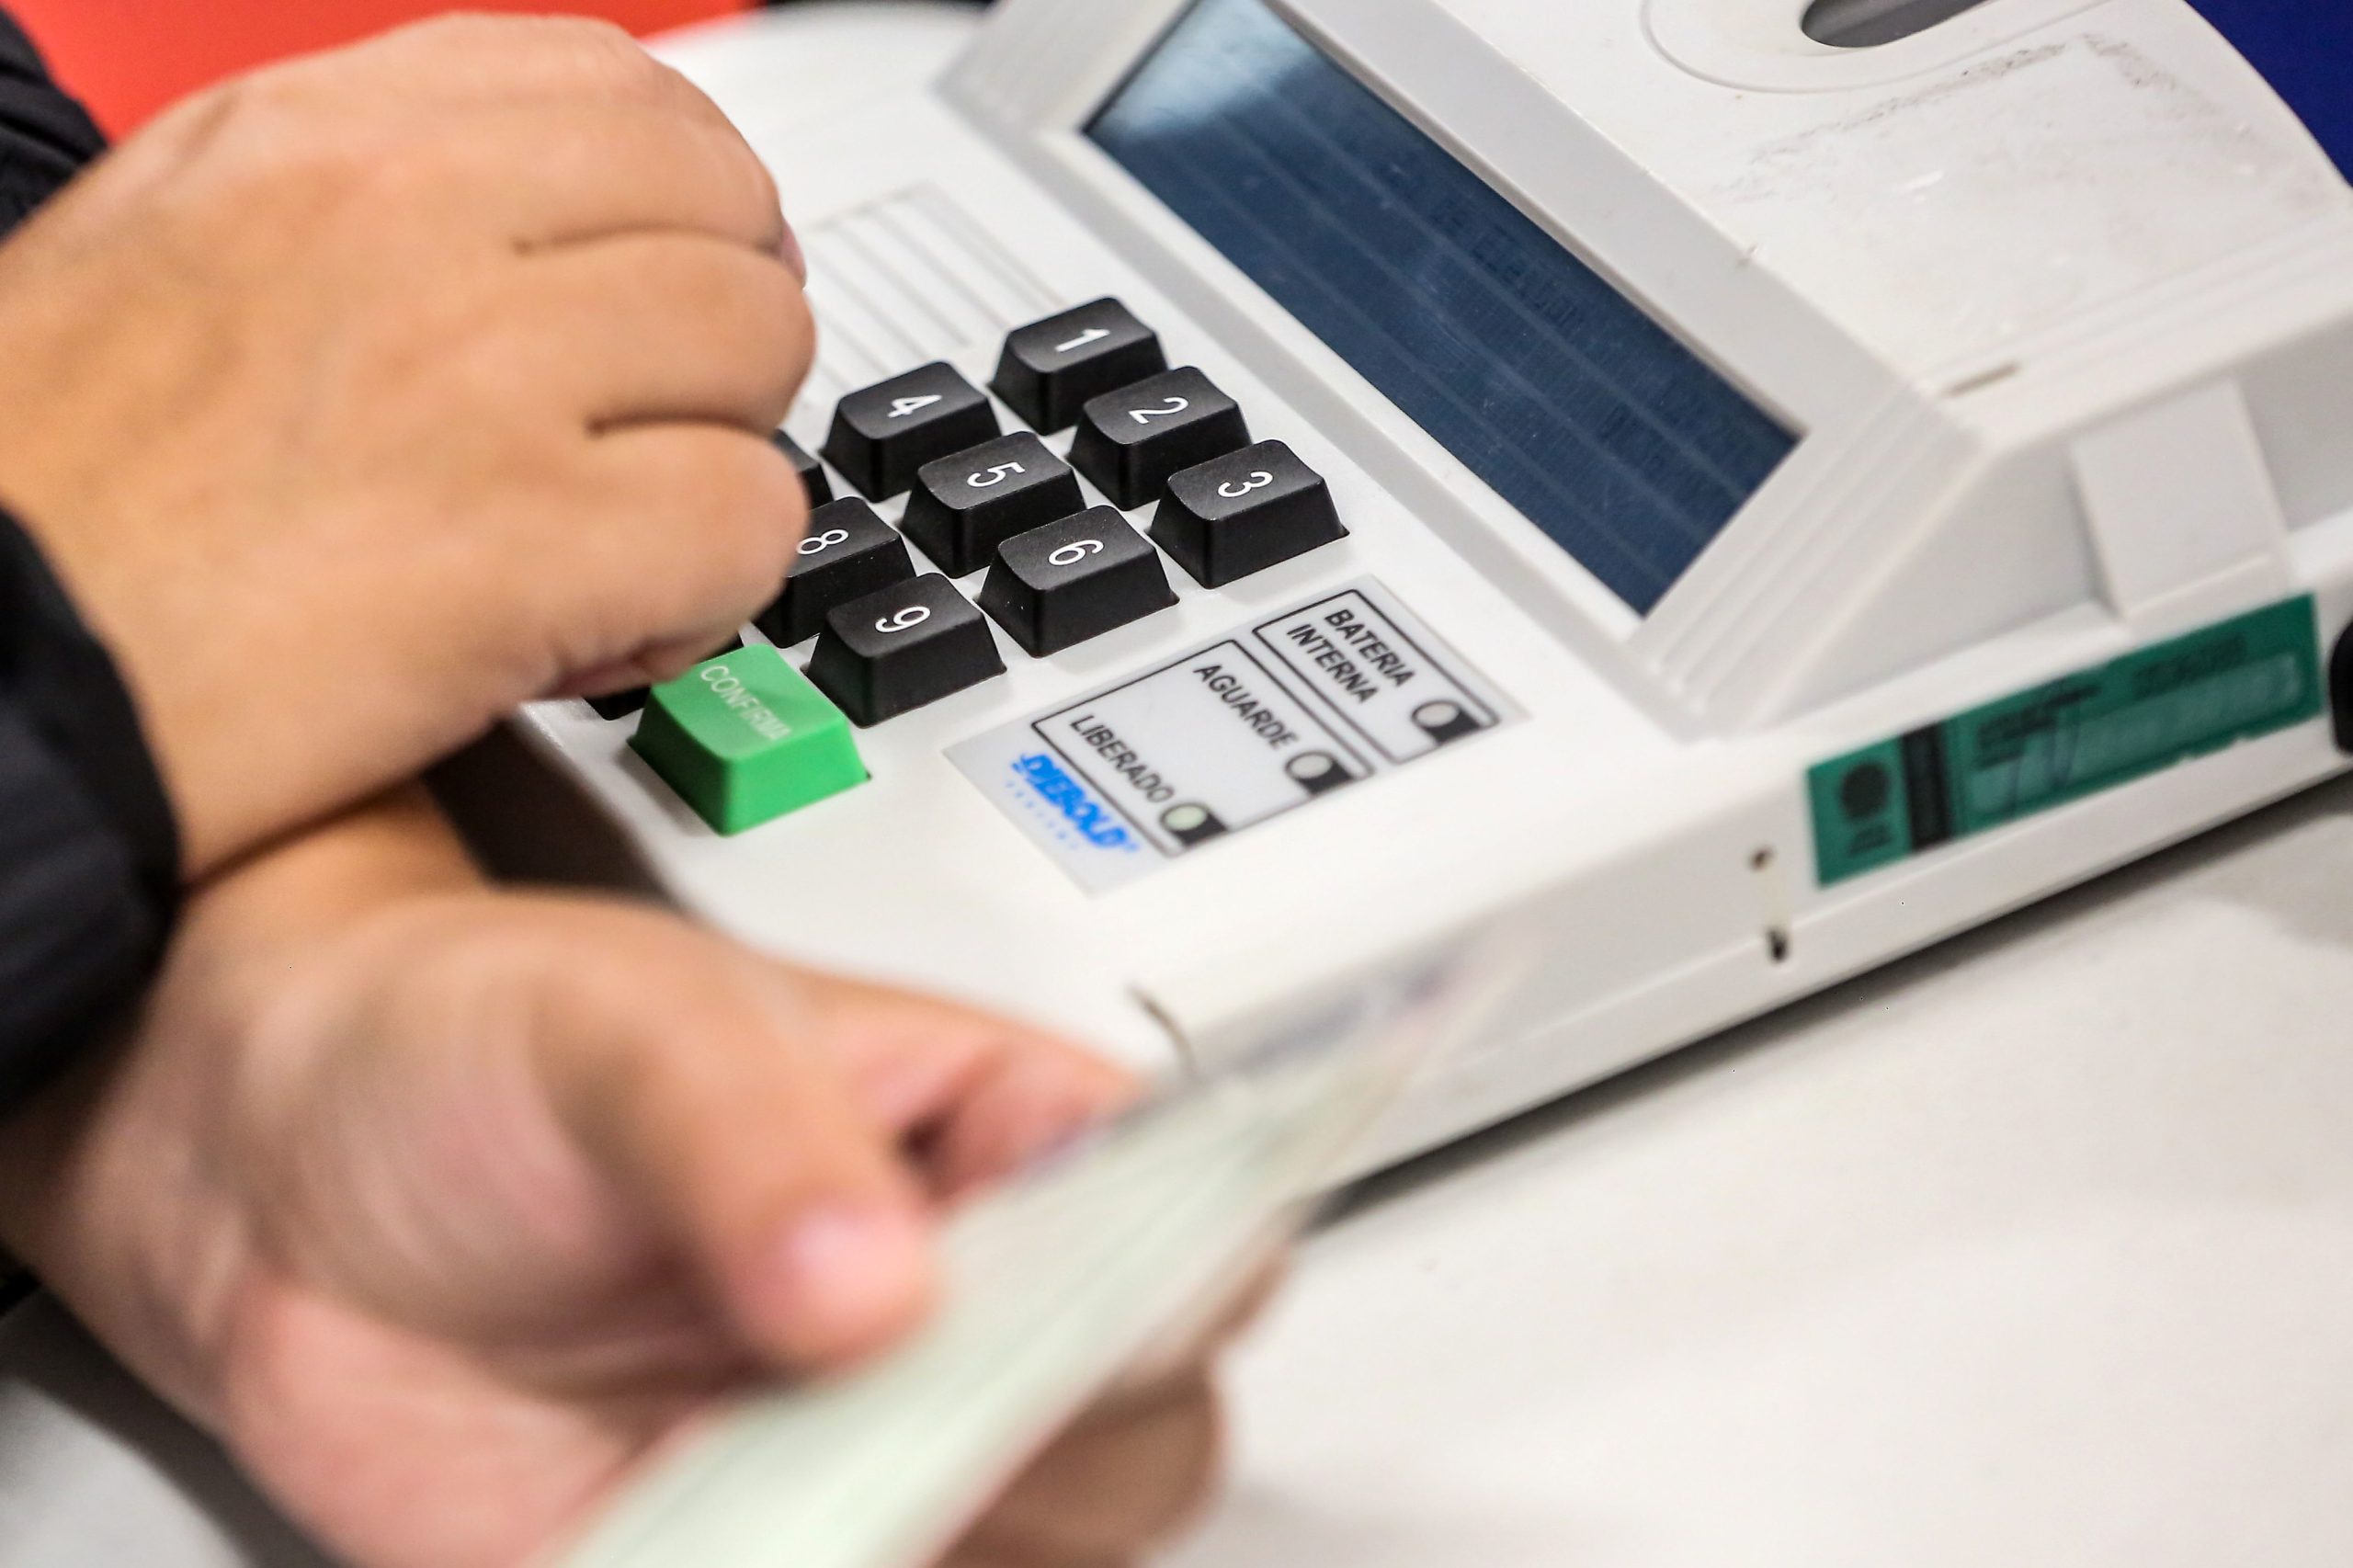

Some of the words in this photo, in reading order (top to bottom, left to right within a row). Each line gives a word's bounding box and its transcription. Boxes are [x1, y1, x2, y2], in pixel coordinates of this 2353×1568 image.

[1054, 328, 1110, 352] 1
[887, 394, 942, 418] 4
[1128, 397, 1188, 425] 2
[967, 461, 1026, 487] 5
[1217, 471, 1273, 497] 3
[796, 528, 849, 555] 8
[1048, 540, 1104, 566] 6
[875, 606, 930, 632] 9
[1324, 608, 1415, 687] BATERIA
[1287, 623, 1380, 703] INTERNA
[1193, 664, 1299, 749] AGUARDE
[1070, 715, 1175, 803] LIBERADO
